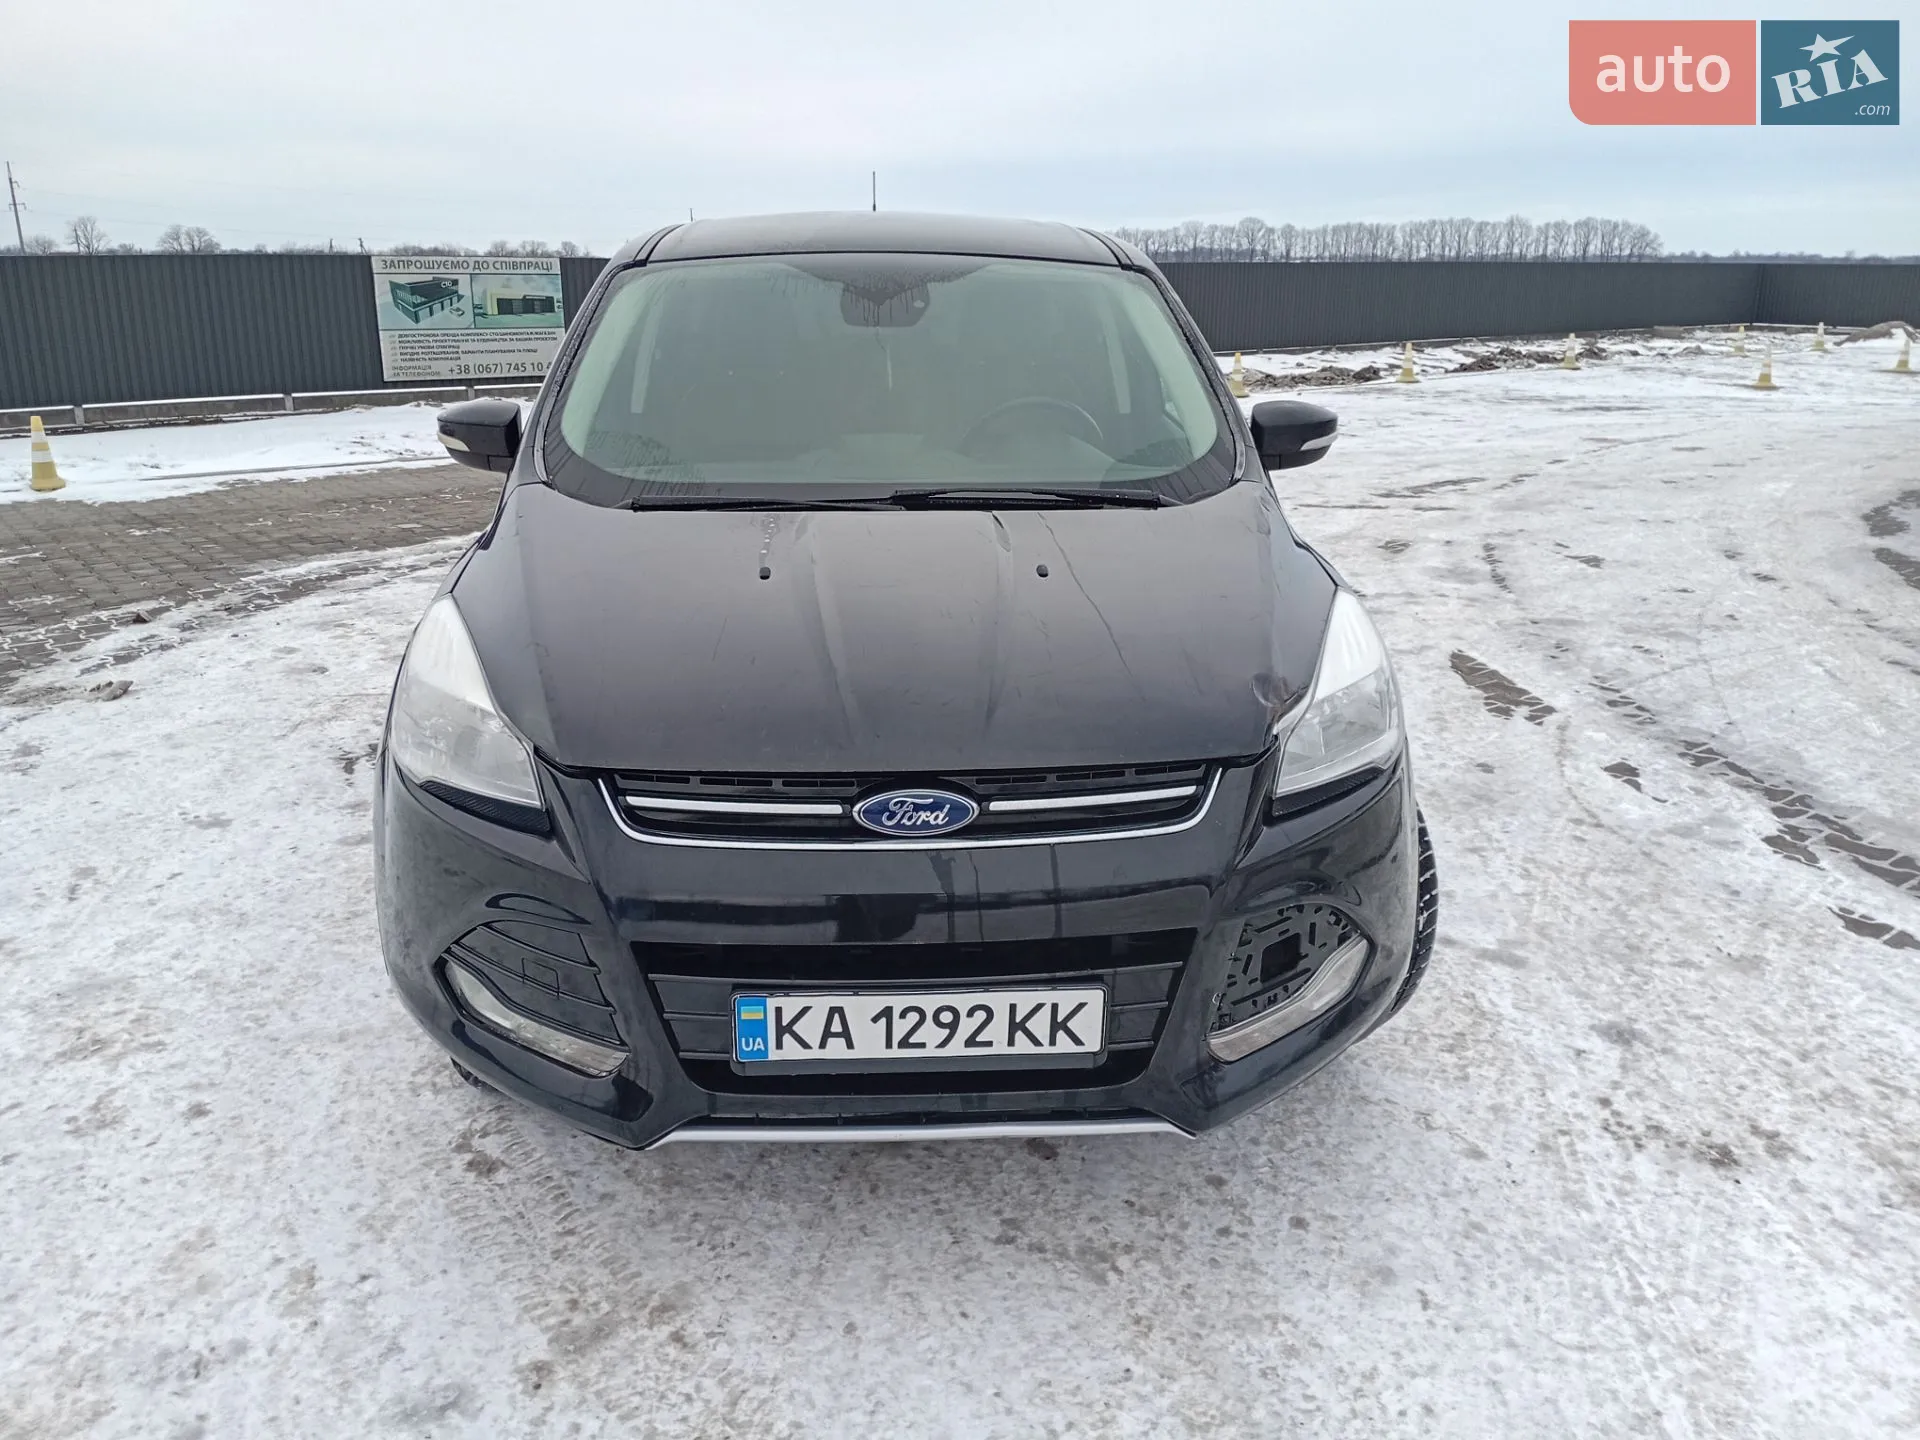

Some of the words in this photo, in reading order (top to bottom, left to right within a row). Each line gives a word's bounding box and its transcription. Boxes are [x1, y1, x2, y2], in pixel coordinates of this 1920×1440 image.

[381, 259, 470, 271] ЗАПРОШУЄМО
[472, 260, 490, 272] ДО
[492, 260, 553, 272] СПІВПРАЦІ
[448, 364, 471, 375] +38
[473, 363, 504, 375] (067)
[506, 362, 527, 373] 745
[531, 361, 543, 372] 10
[882, 797, 951, 826] Ford
[774, 1005, 856, 1051] KA
[870, 1004, 995, 1050] 1292
[1006, 1001, 1089, 1048] KK
[740, 1037, 766, 1053] UA
